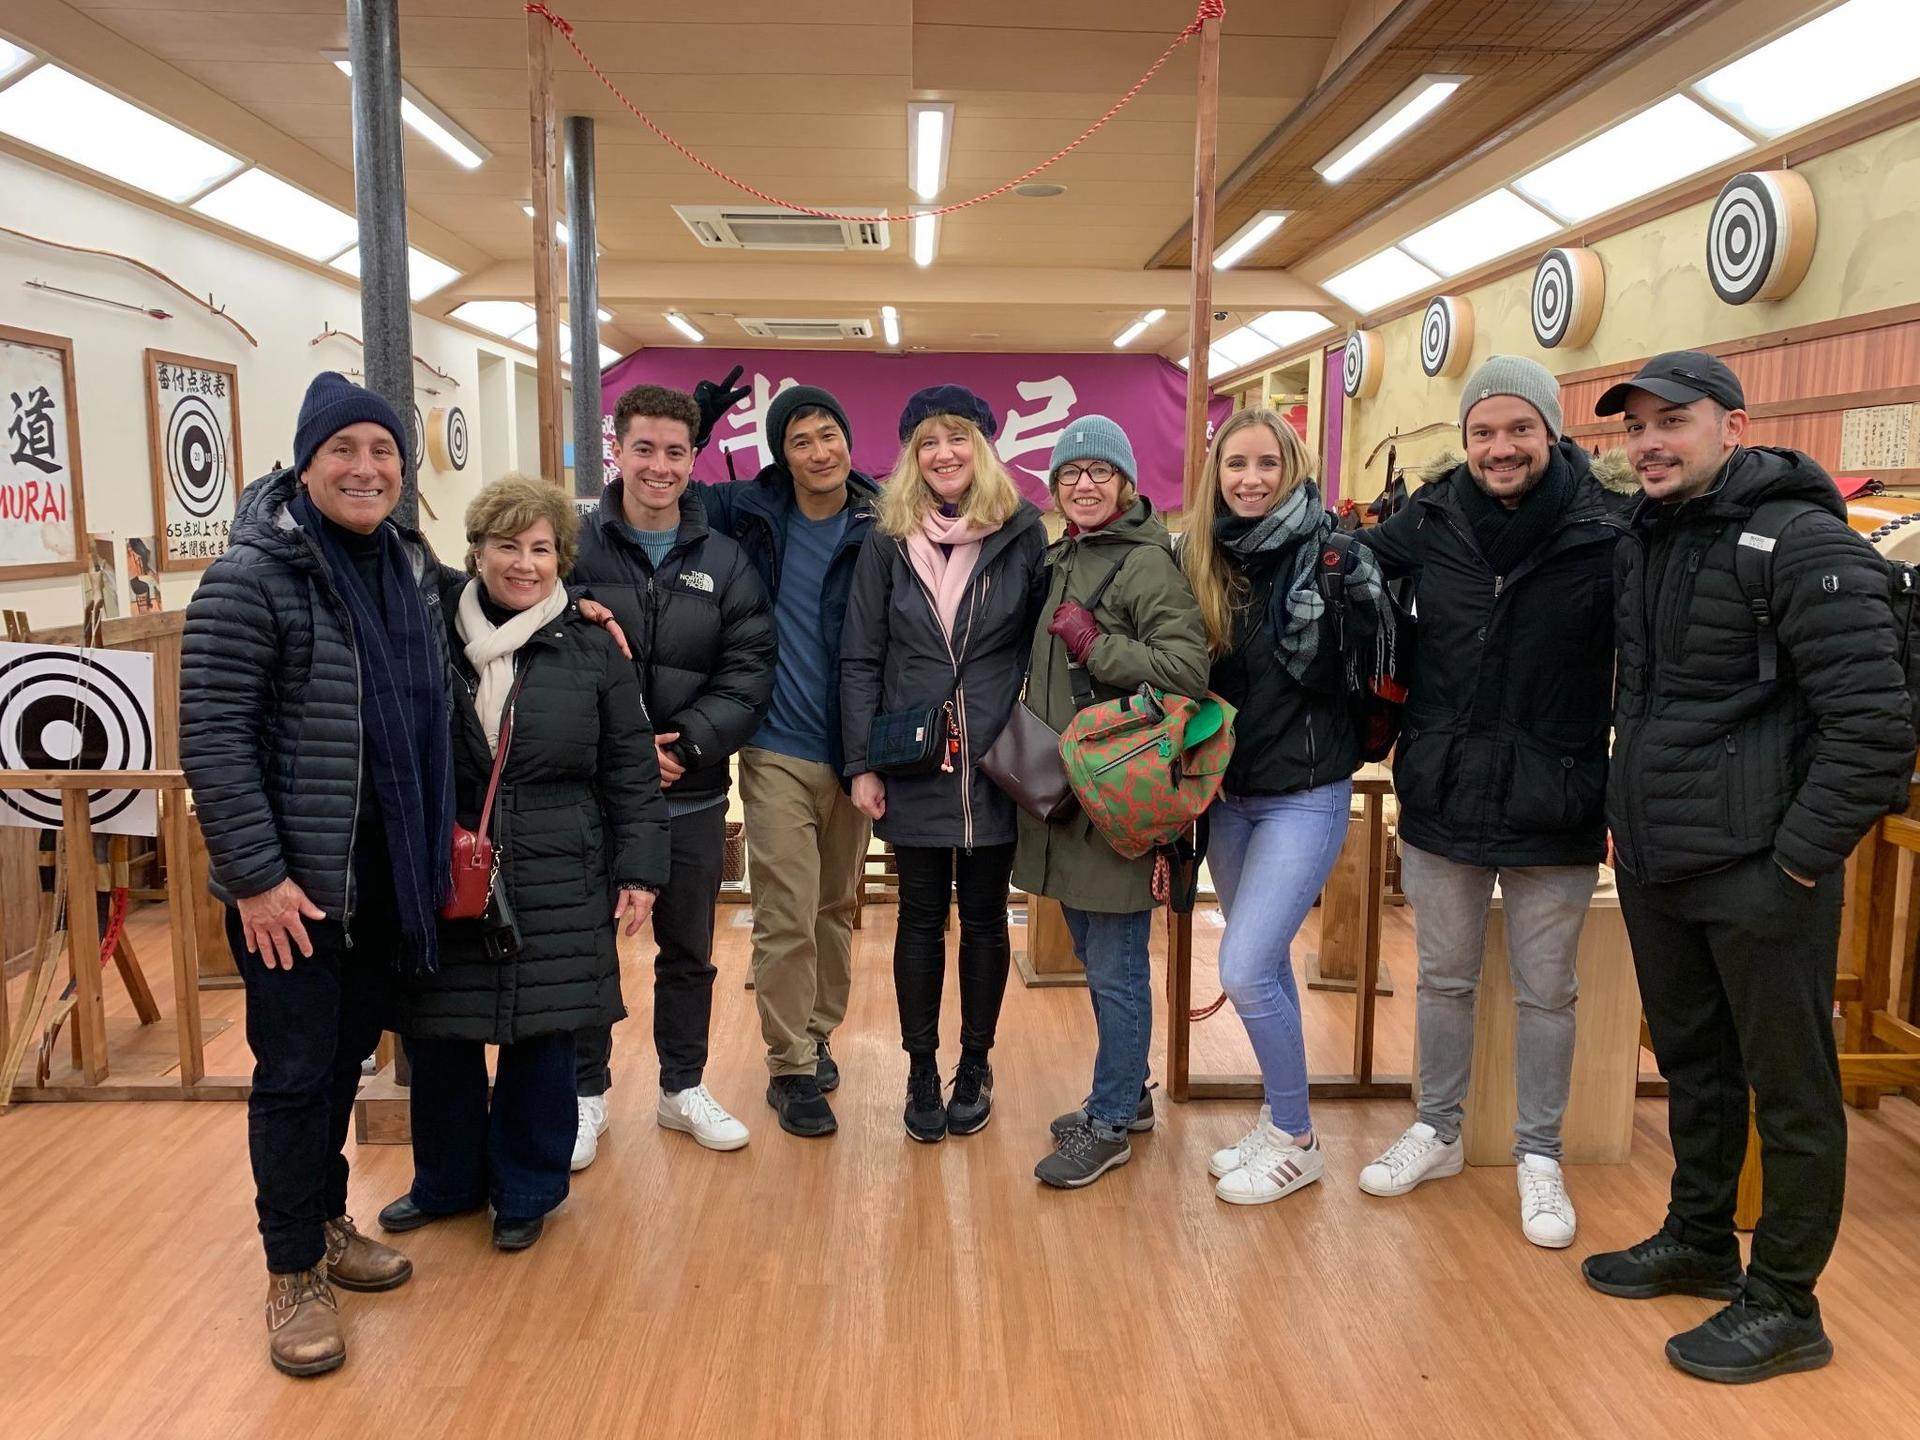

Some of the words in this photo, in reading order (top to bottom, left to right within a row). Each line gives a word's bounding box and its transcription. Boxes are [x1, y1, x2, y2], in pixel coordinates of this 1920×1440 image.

[158, 362, 225, 398] 番付点数表
[8, 386, 63, 474] 道
